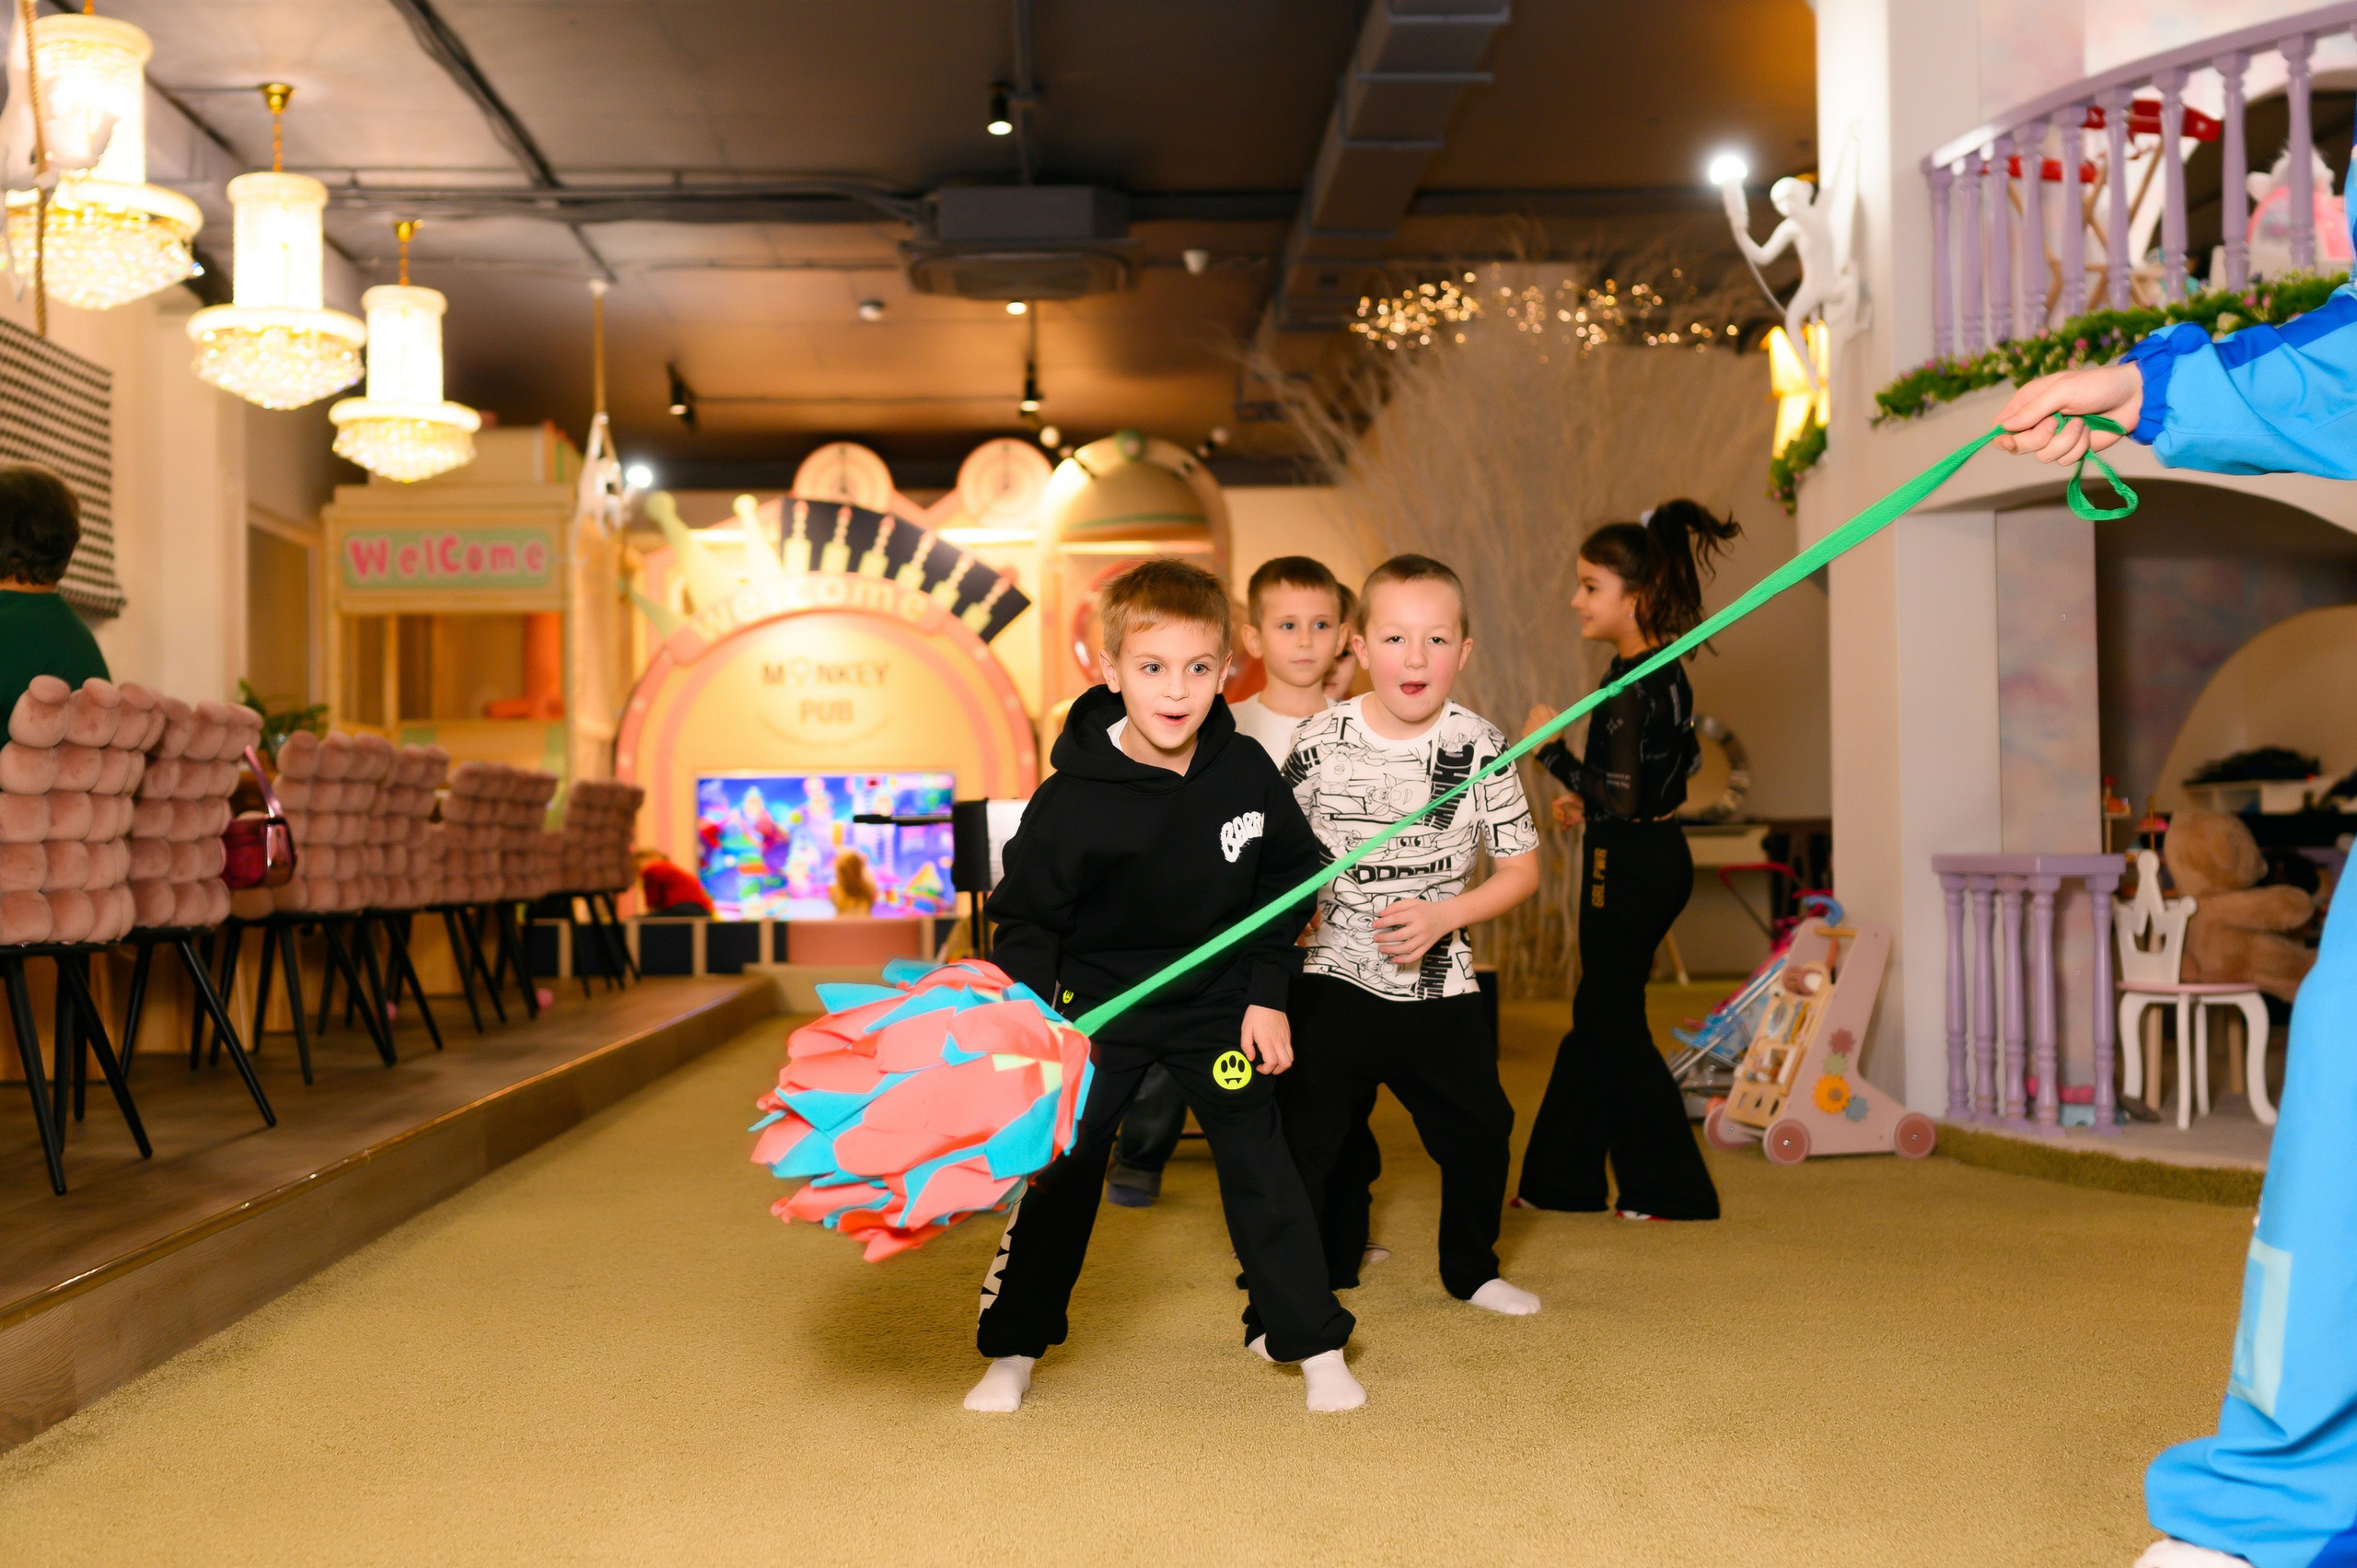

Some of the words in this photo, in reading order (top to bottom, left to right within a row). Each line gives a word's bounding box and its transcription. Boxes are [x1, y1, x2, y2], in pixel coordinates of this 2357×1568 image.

[691, 576, 927, 641] welcome
[799, 699, 853, 724] PUB
[1220, 811, 1264, 863] BARR
